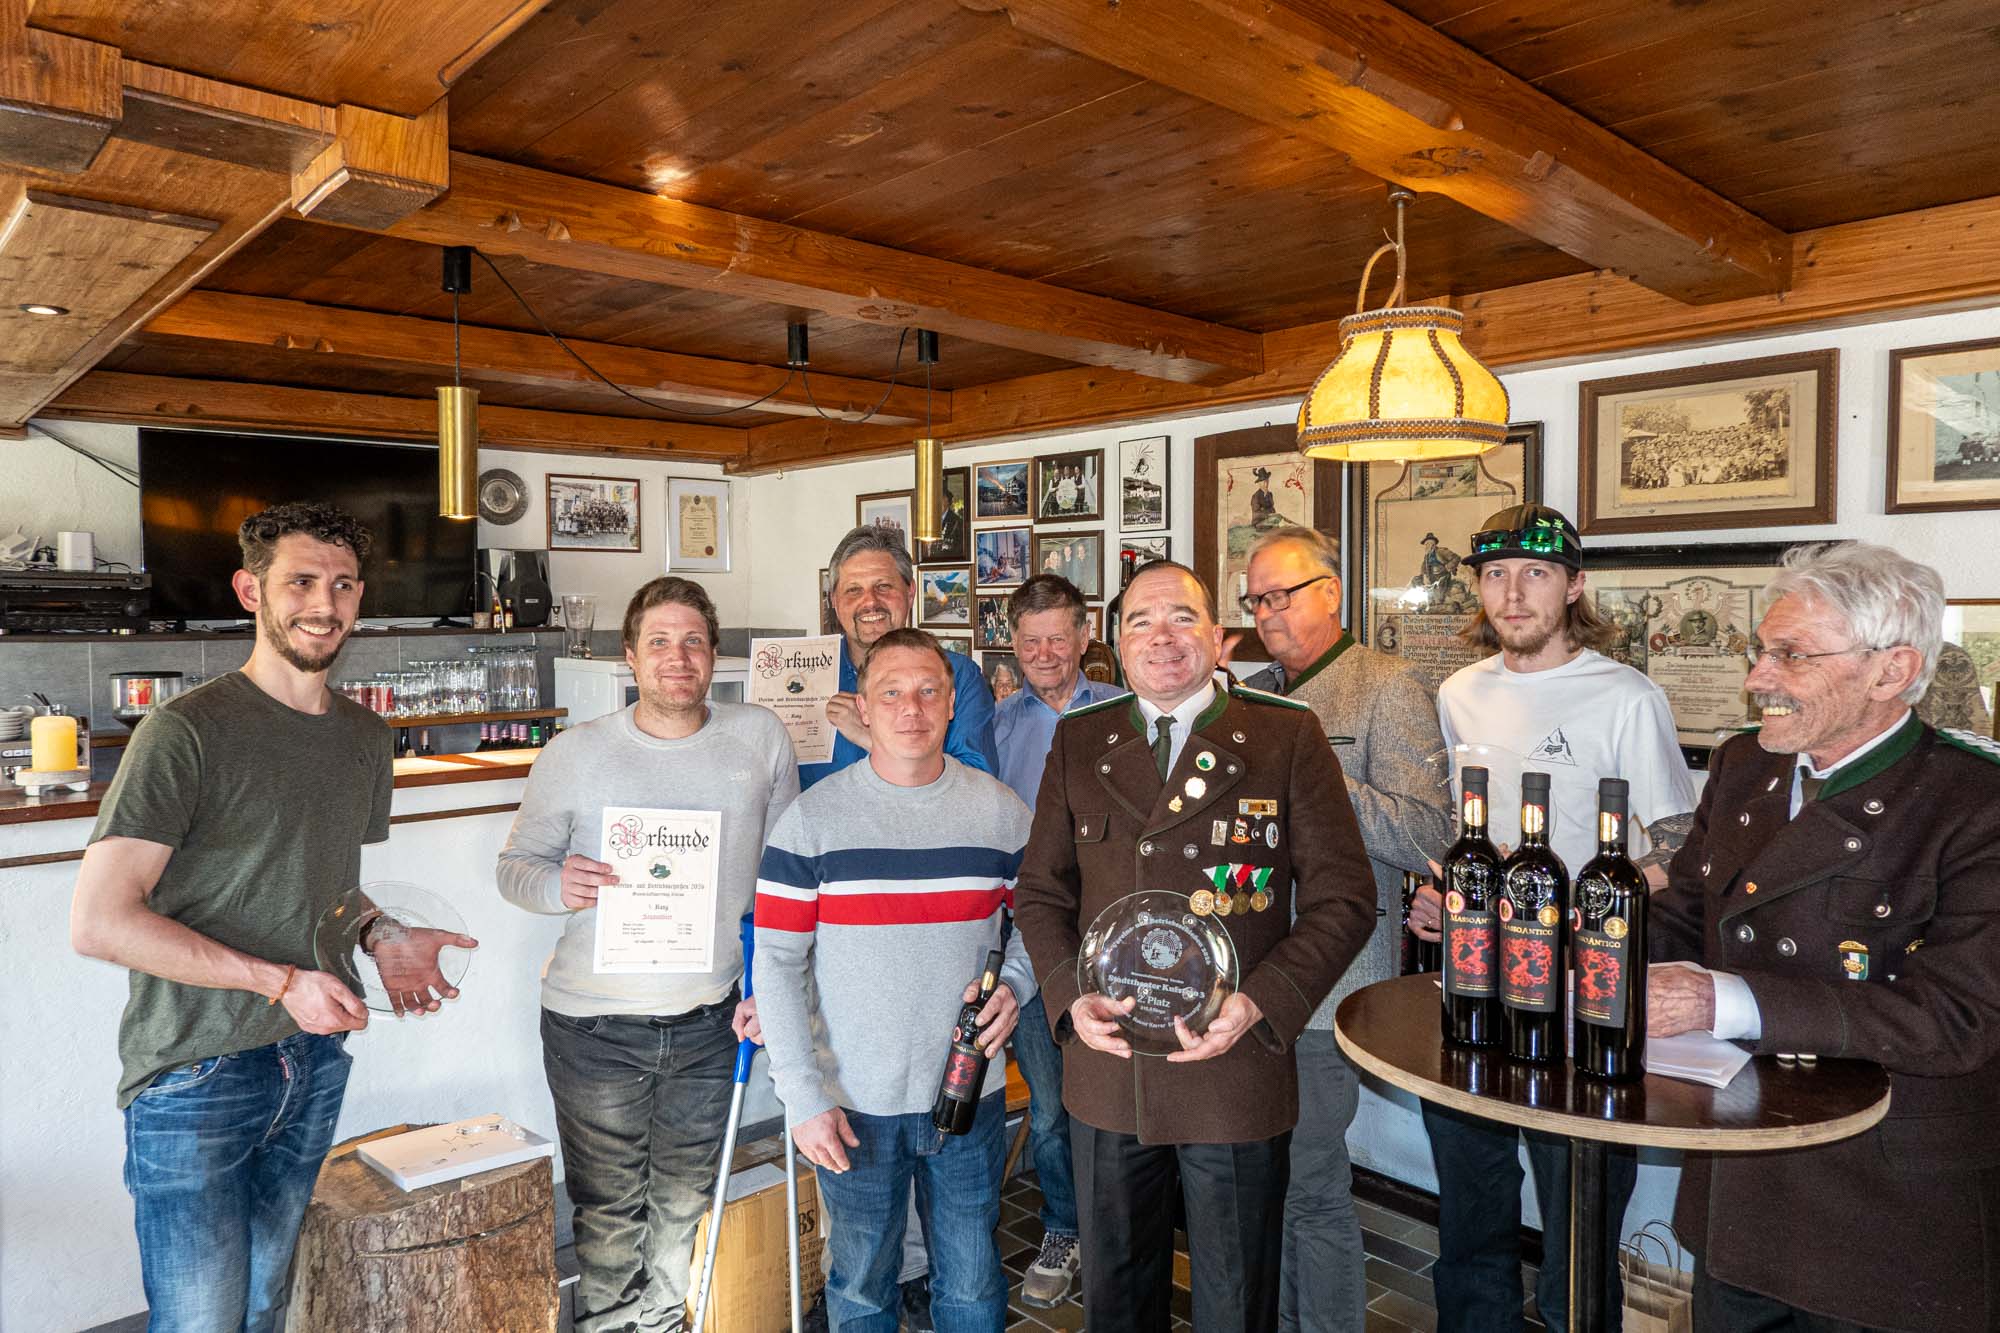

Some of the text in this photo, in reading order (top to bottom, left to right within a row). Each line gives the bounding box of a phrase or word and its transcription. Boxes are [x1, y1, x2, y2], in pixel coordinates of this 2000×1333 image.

[756, 644, 832, 679] Urkunde
[609, 815, 709, 859] Urkunde
[1108, 974, 1162, 990] Stadttheater
[1137, 994, 1171, 1008] 2. Platz
